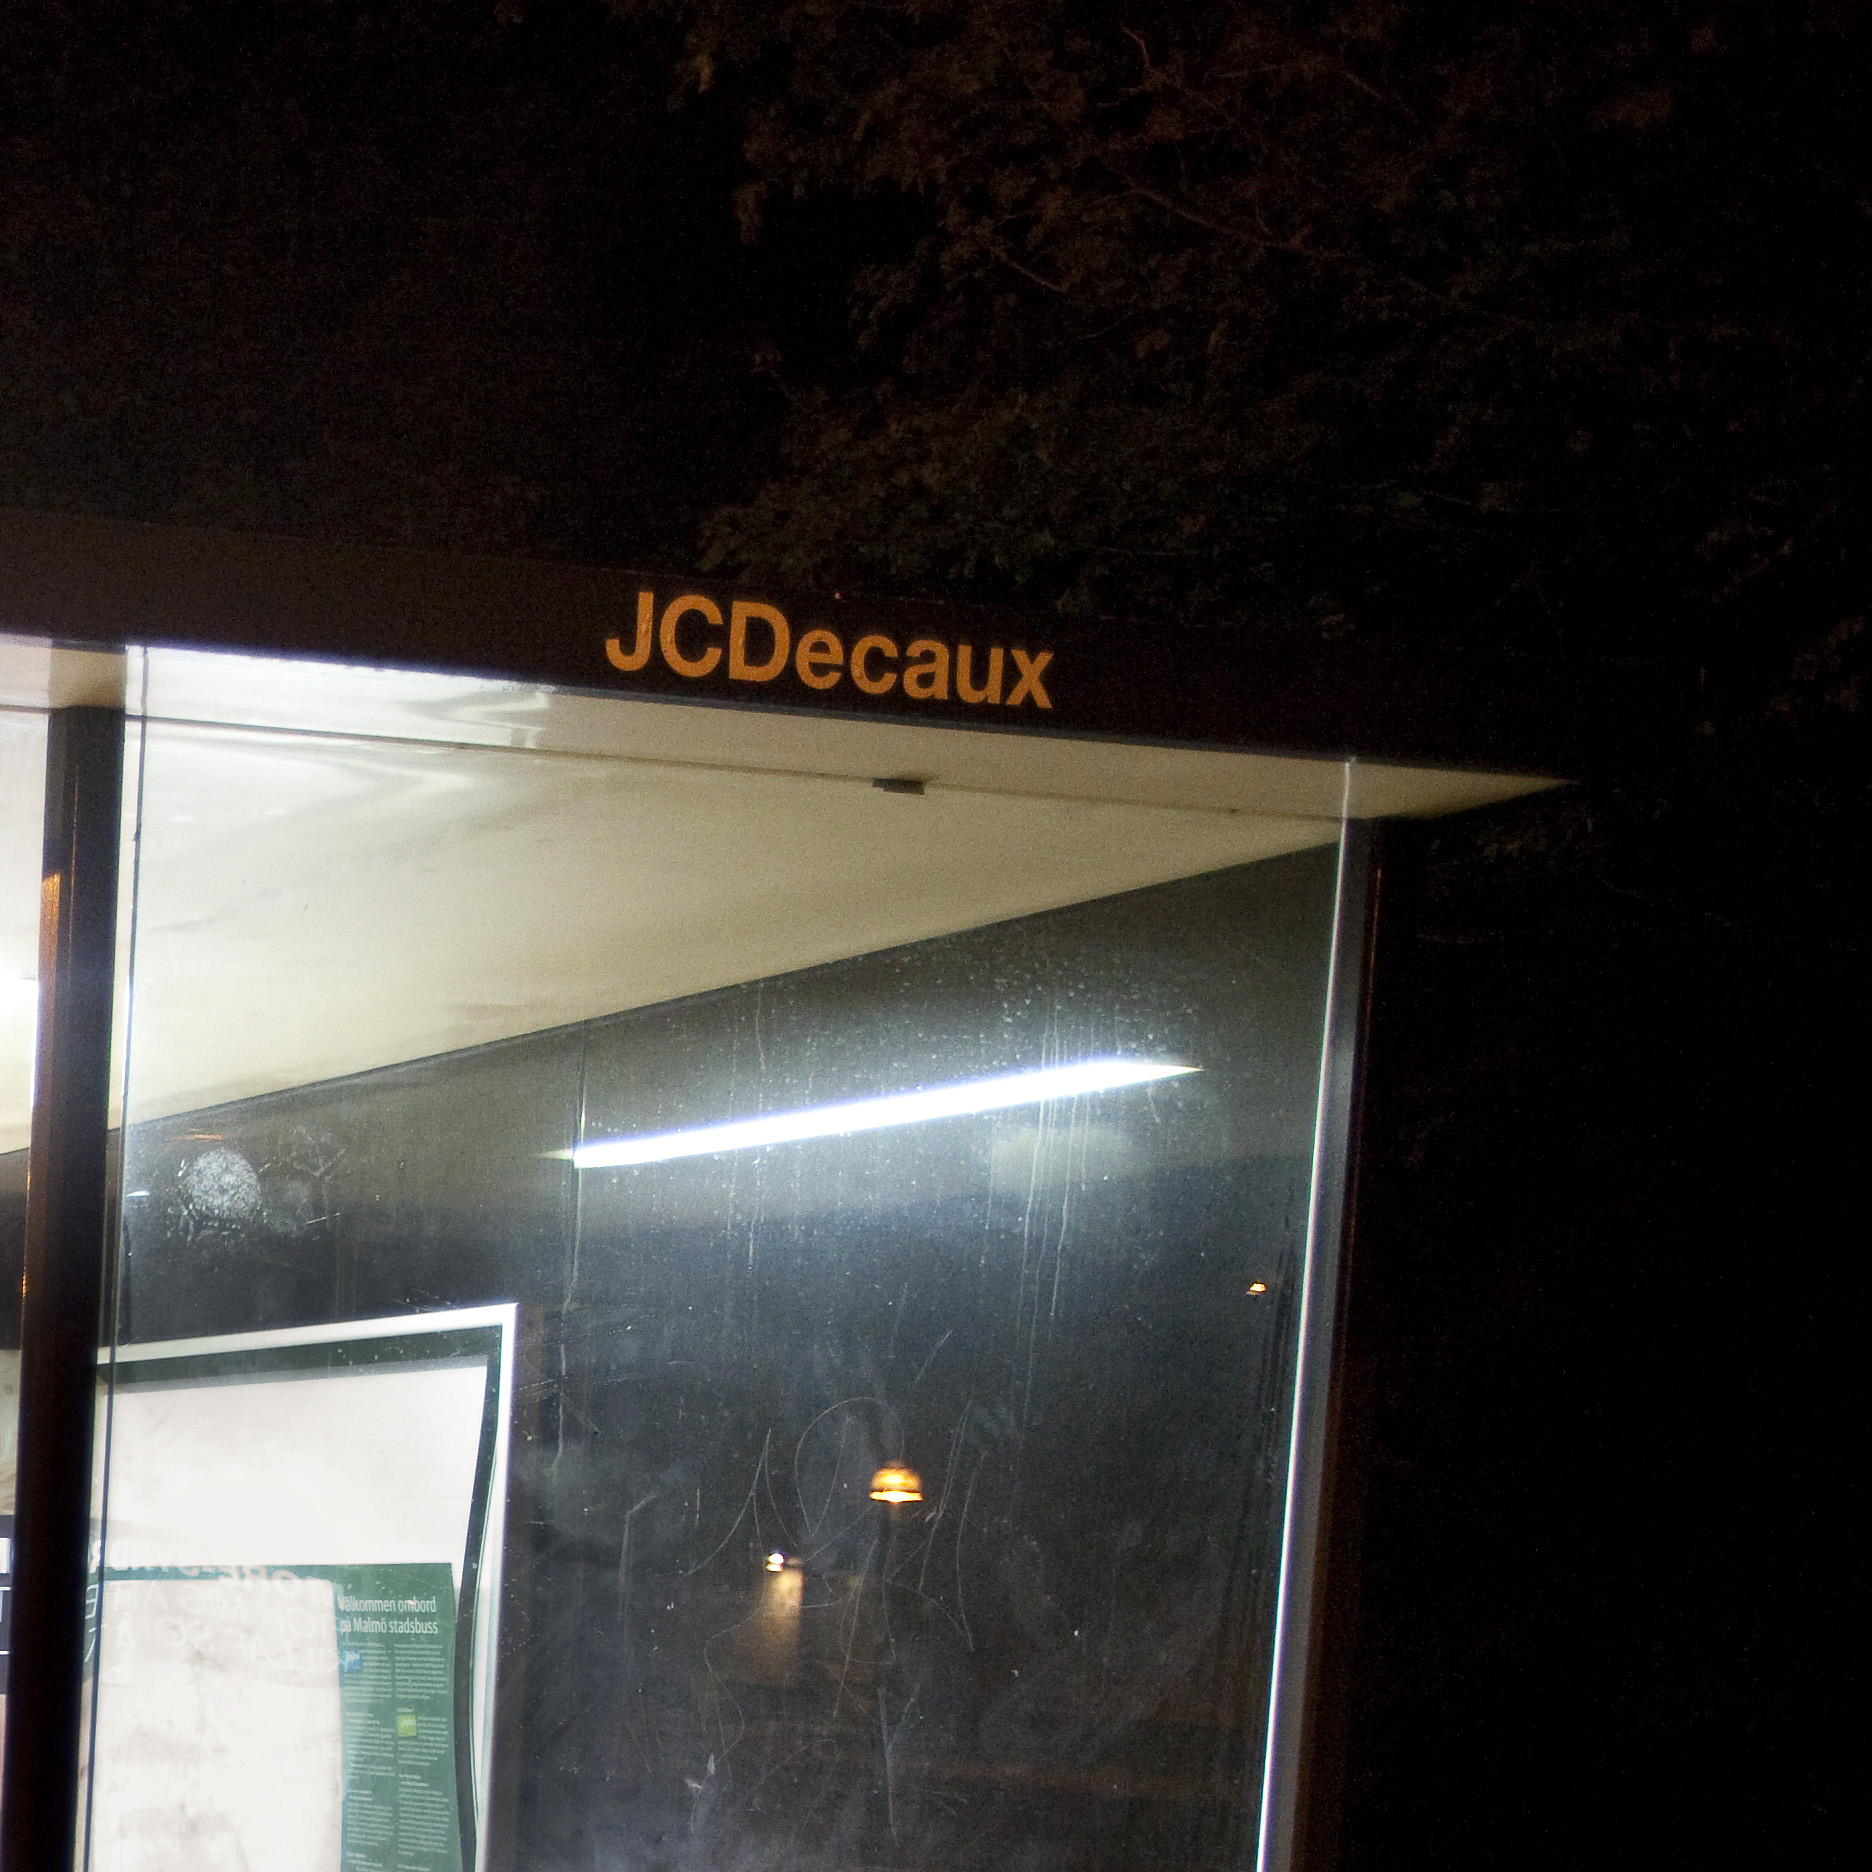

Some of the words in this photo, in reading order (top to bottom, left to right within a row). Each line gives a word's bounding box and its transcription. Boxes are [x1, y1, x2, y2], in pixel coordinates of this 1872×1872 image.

[605, 591, 1054, 709] JCDecaux
[337, 1595, 396, 1613] Välkommen
[397, 1595, 437, 1613] ombord
[353, 1617, 387, 1633] Malmö
[389, 1617, 439, 1635] stadsbuss
